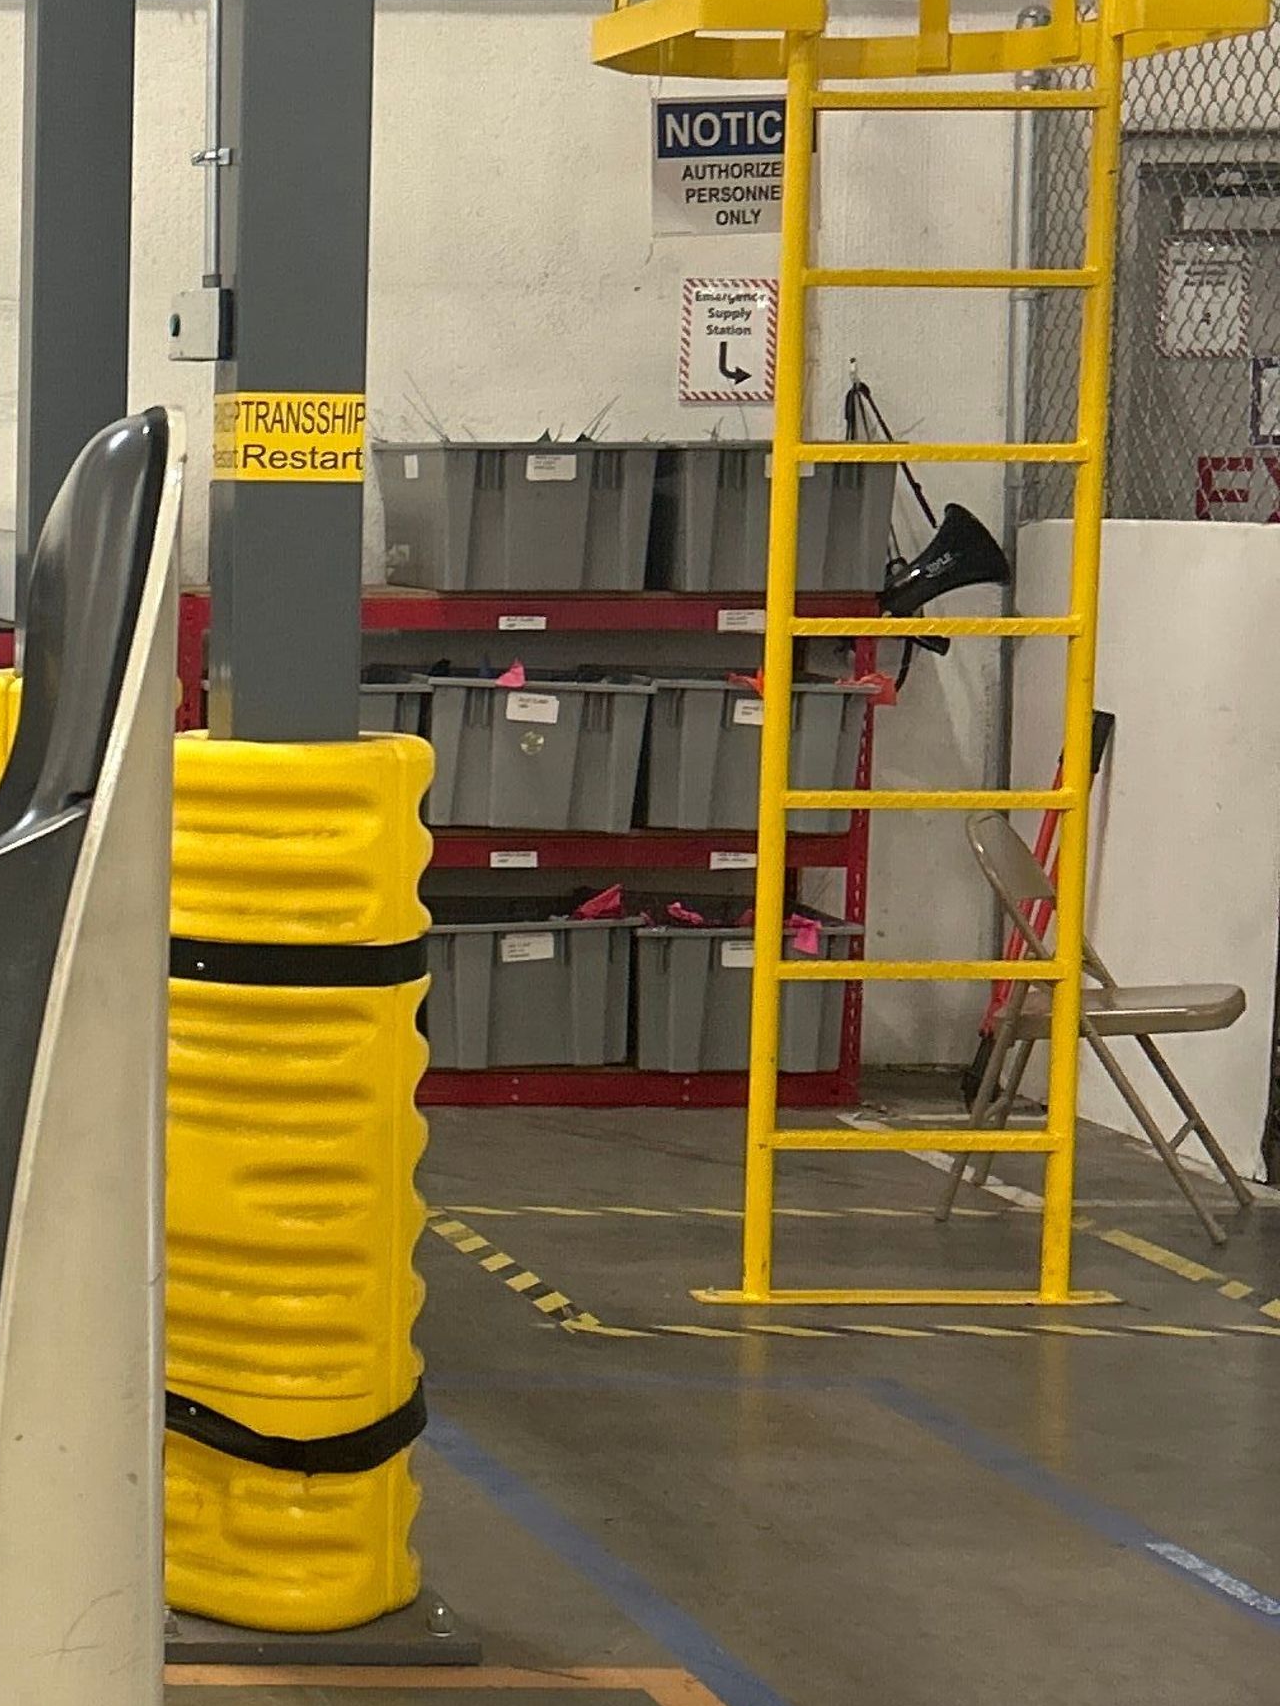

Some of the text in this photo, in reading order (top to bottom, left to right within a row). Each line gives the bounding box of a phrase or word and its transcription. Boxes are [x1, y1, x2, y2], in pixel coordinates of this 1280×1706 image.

[664, 109, 783, 149] NOTIC
[681, 161, 783, 182] AUTHORIZE
[685, 184, 782, 204] PERSONNE
[715, 208, 762, 226] ONLY
[707, 307, 752, 321] Supply
[705, 324, 752, 336] Station
[242, 443, 364, 470] Restart
